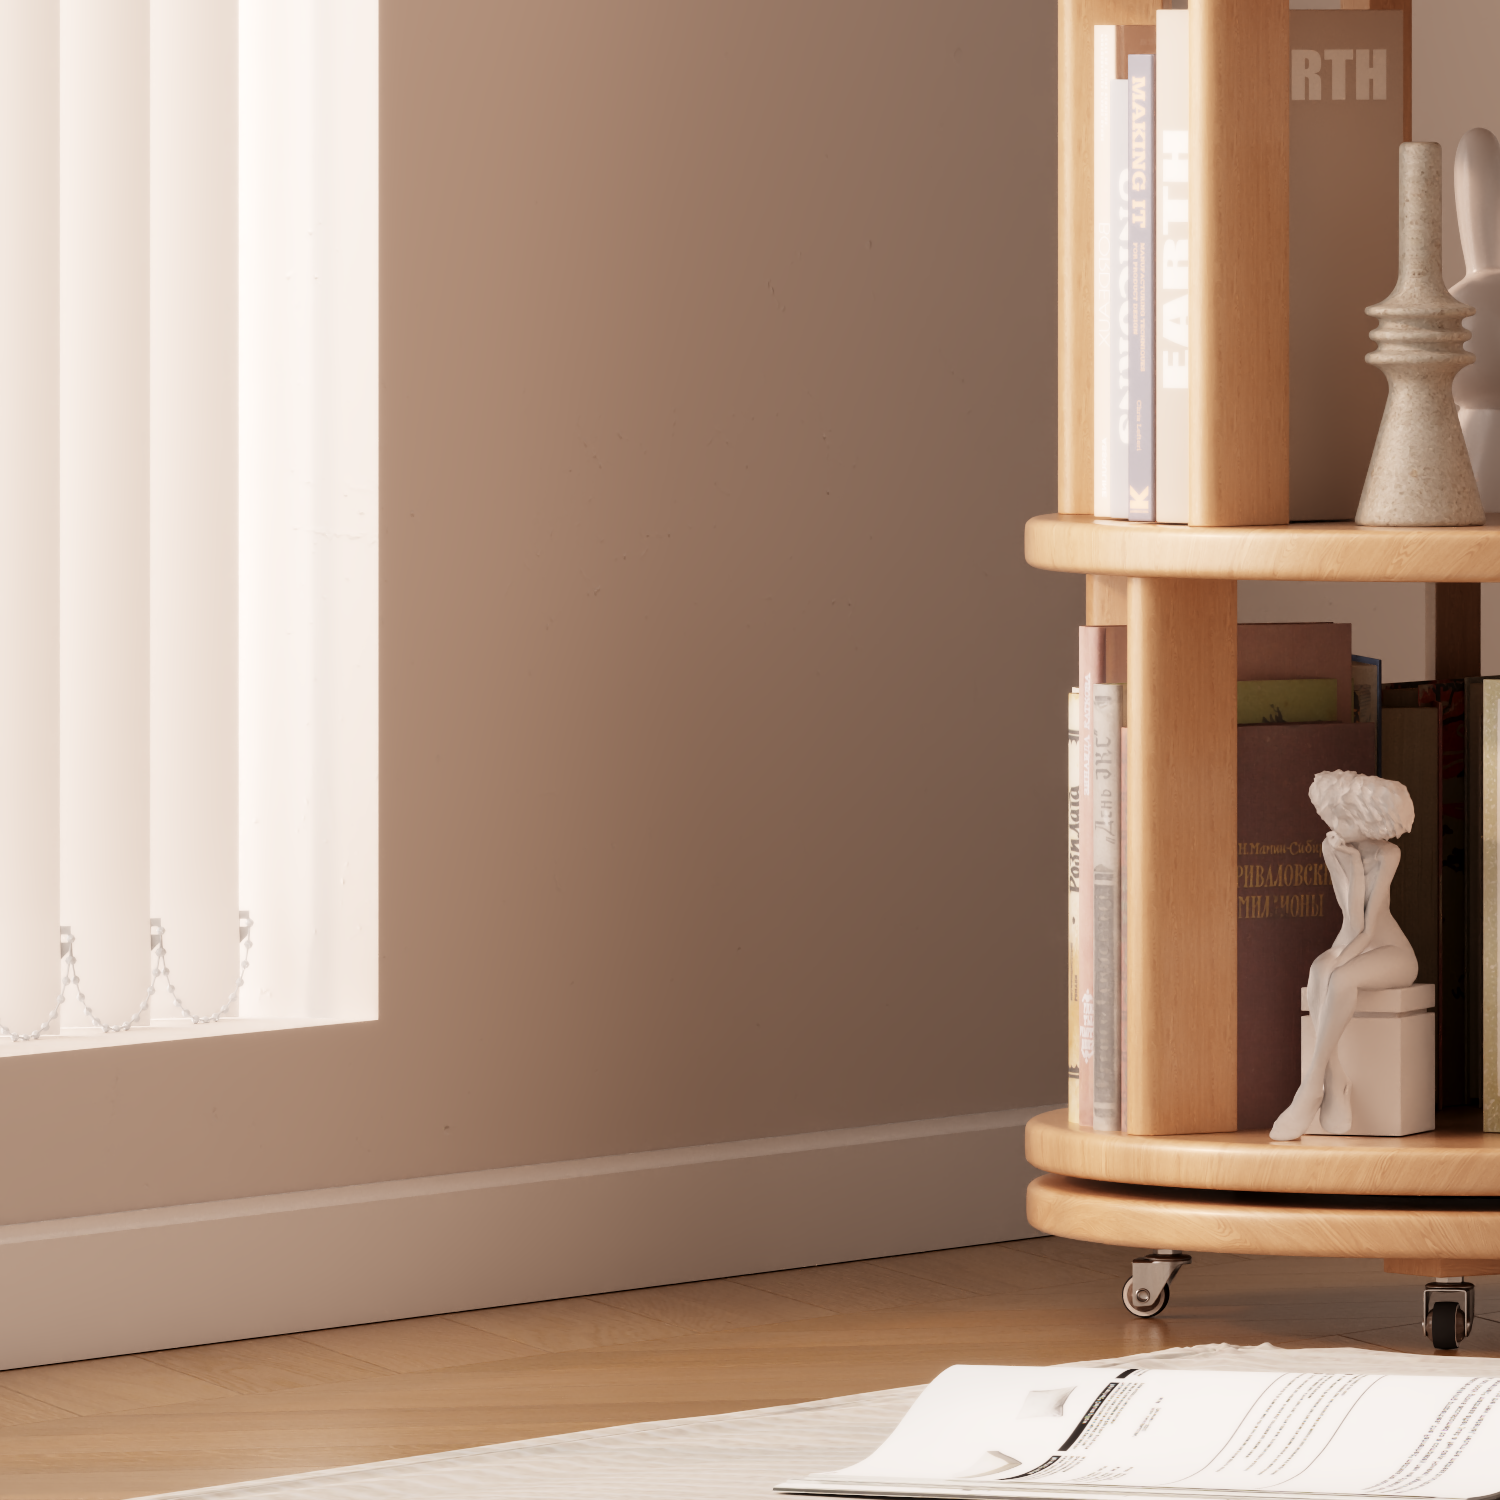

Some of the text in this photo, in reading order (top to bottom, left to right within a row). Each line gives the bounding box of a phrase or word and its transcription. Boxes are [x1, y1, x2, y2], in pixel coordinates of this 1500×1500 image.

[1291, 48, 1387, 101] RTH
[1131, 76, 1146, 228] MAKING IT
[1162, 129, 1188, 390] EARTH
